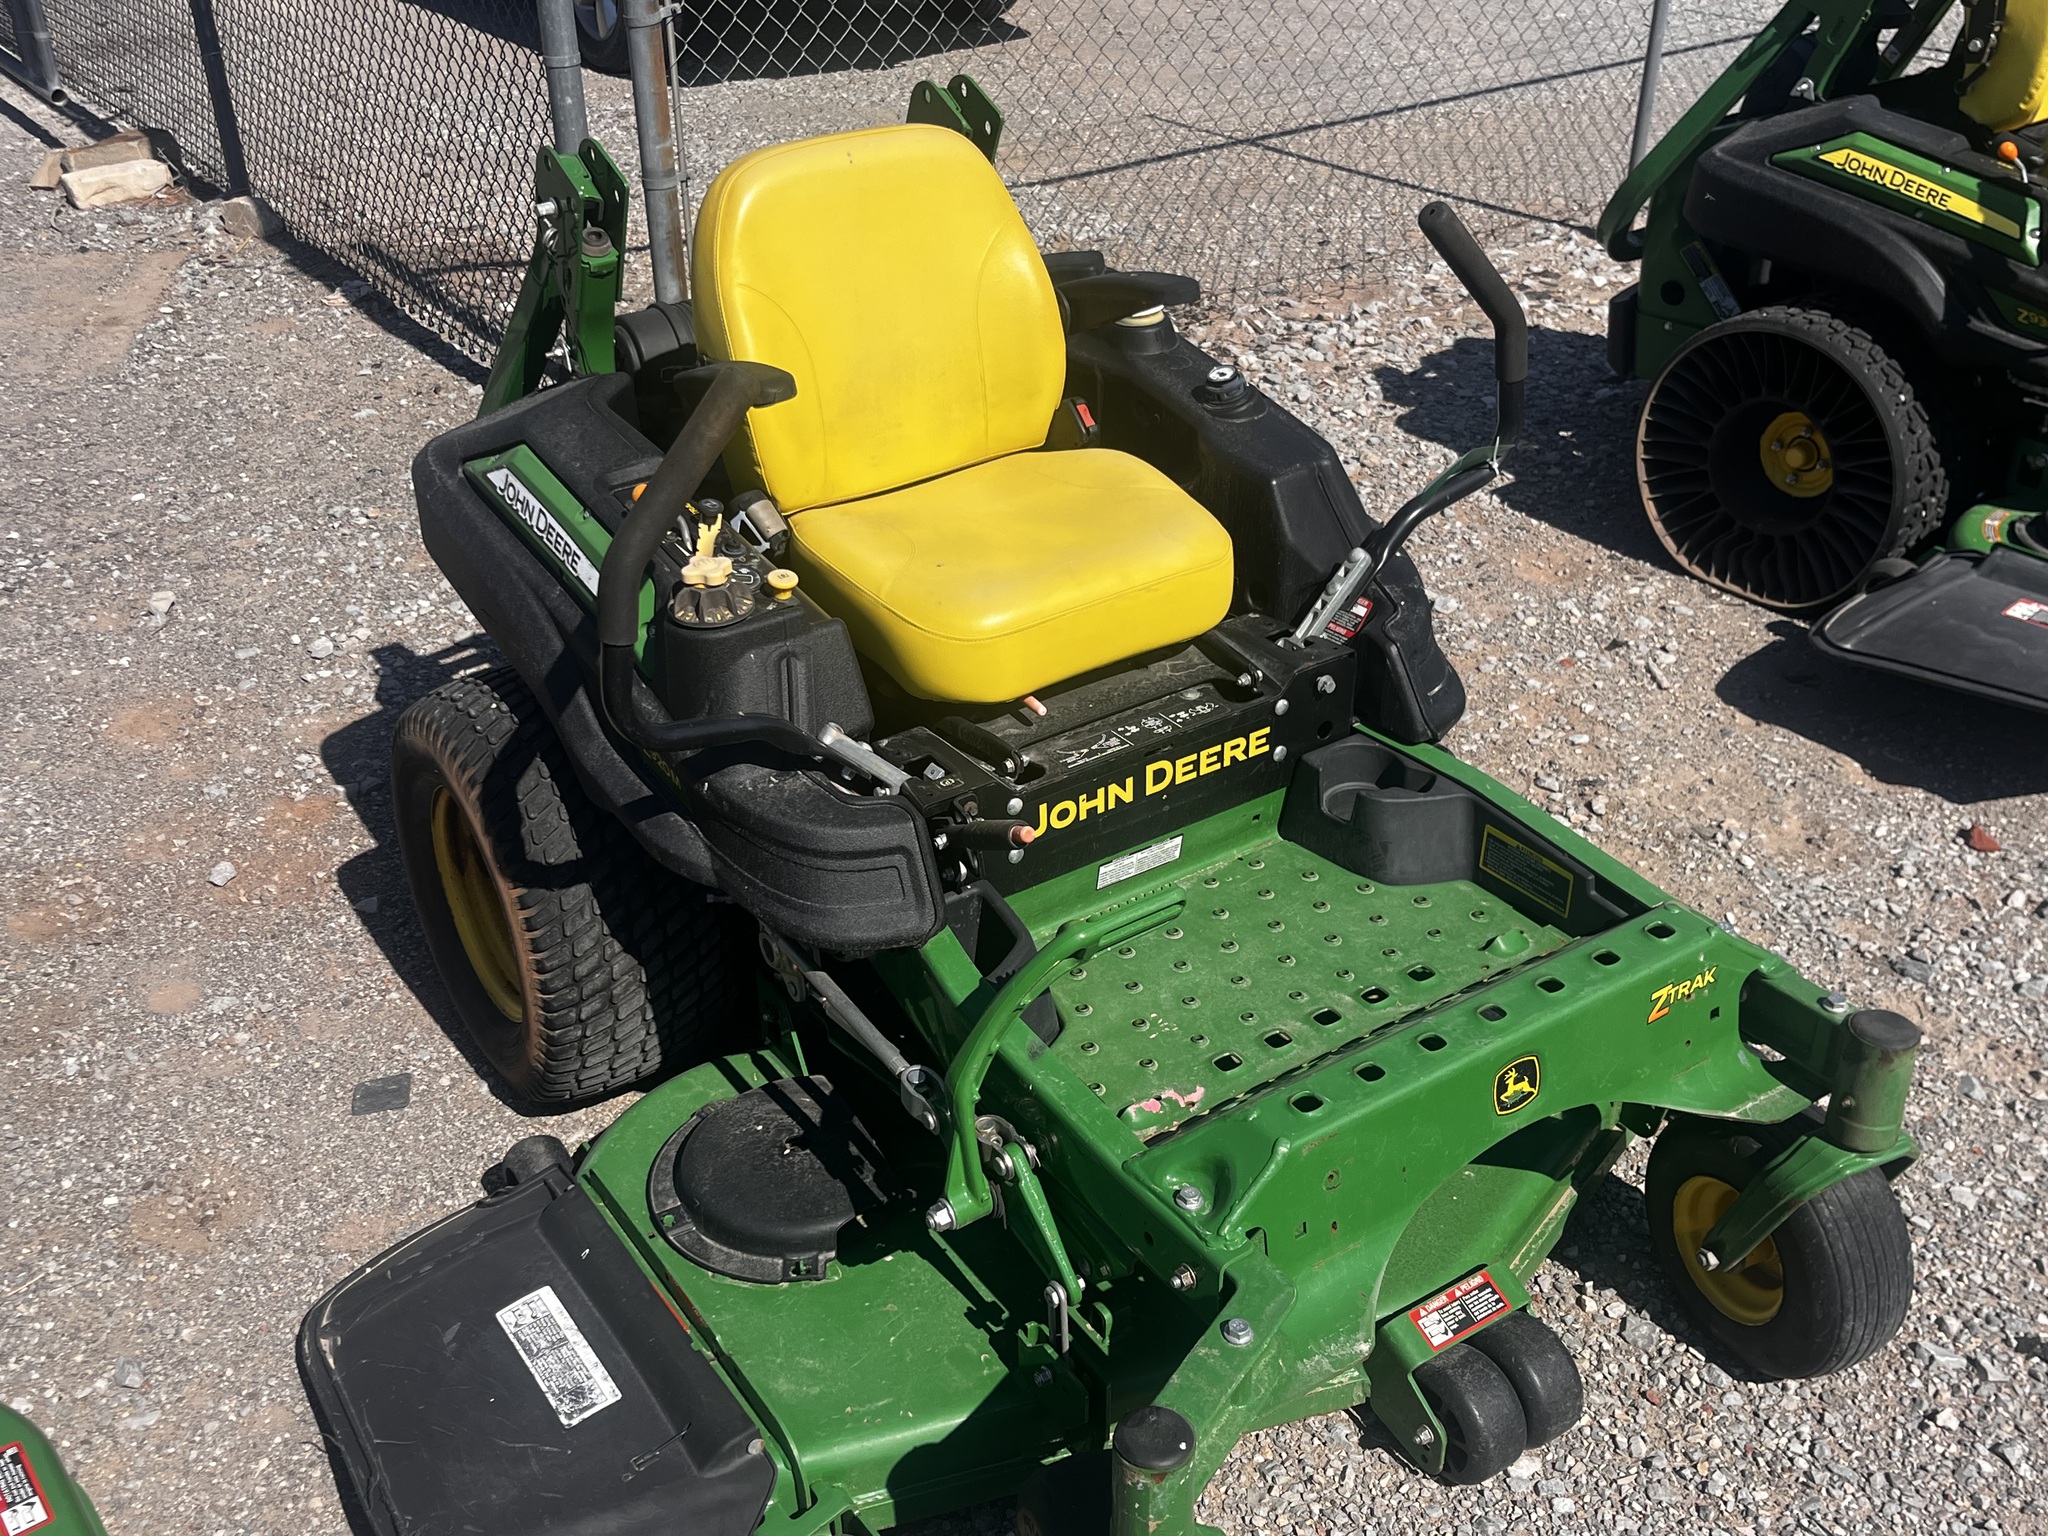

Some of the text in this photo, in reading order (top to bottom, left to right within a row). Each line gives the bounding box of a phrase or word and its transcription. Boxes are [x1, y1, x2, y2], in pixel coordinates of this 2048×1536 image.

[1837, 152, 1952, 208] JOHN DEERE
[498, 473, 581, 574] JOHN DEERE
[1034, 776, 1134, 839] JOHN
[1145, 726, 1271, 796] DEERE
[1425, 1295, 1449, 1312] DANGER
[1460, 1275, 1484, 1293] PELIGRO
